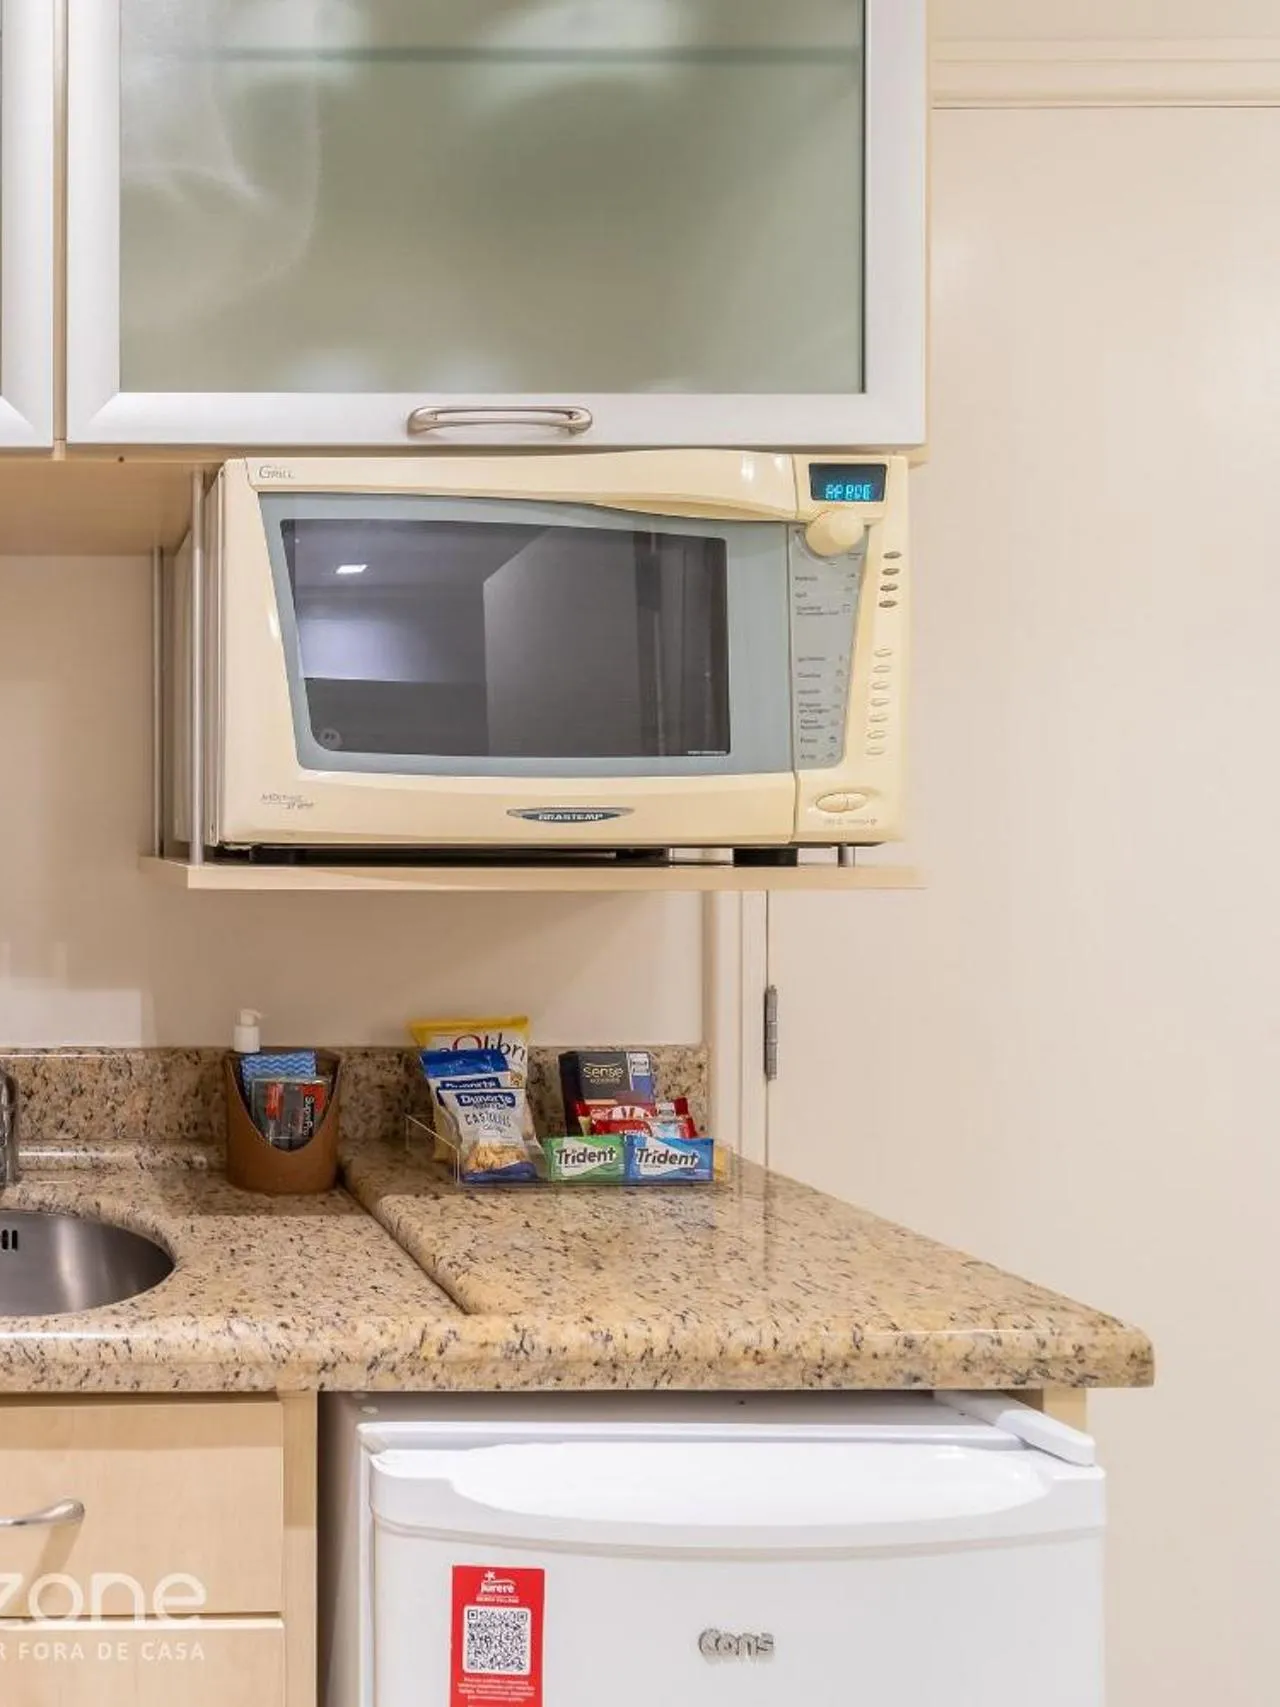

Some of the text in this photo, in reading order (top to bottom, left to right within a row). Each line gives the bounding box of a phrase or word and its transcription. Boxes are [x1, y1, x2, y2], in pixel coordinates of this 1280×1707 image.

[538, 813, 604, 822] BRASTEMP
[583, 1066, 624, 1078] Sense
[555, 1147, 616, 1167] Trident
[636, 1147, 699, 1169] Trident
